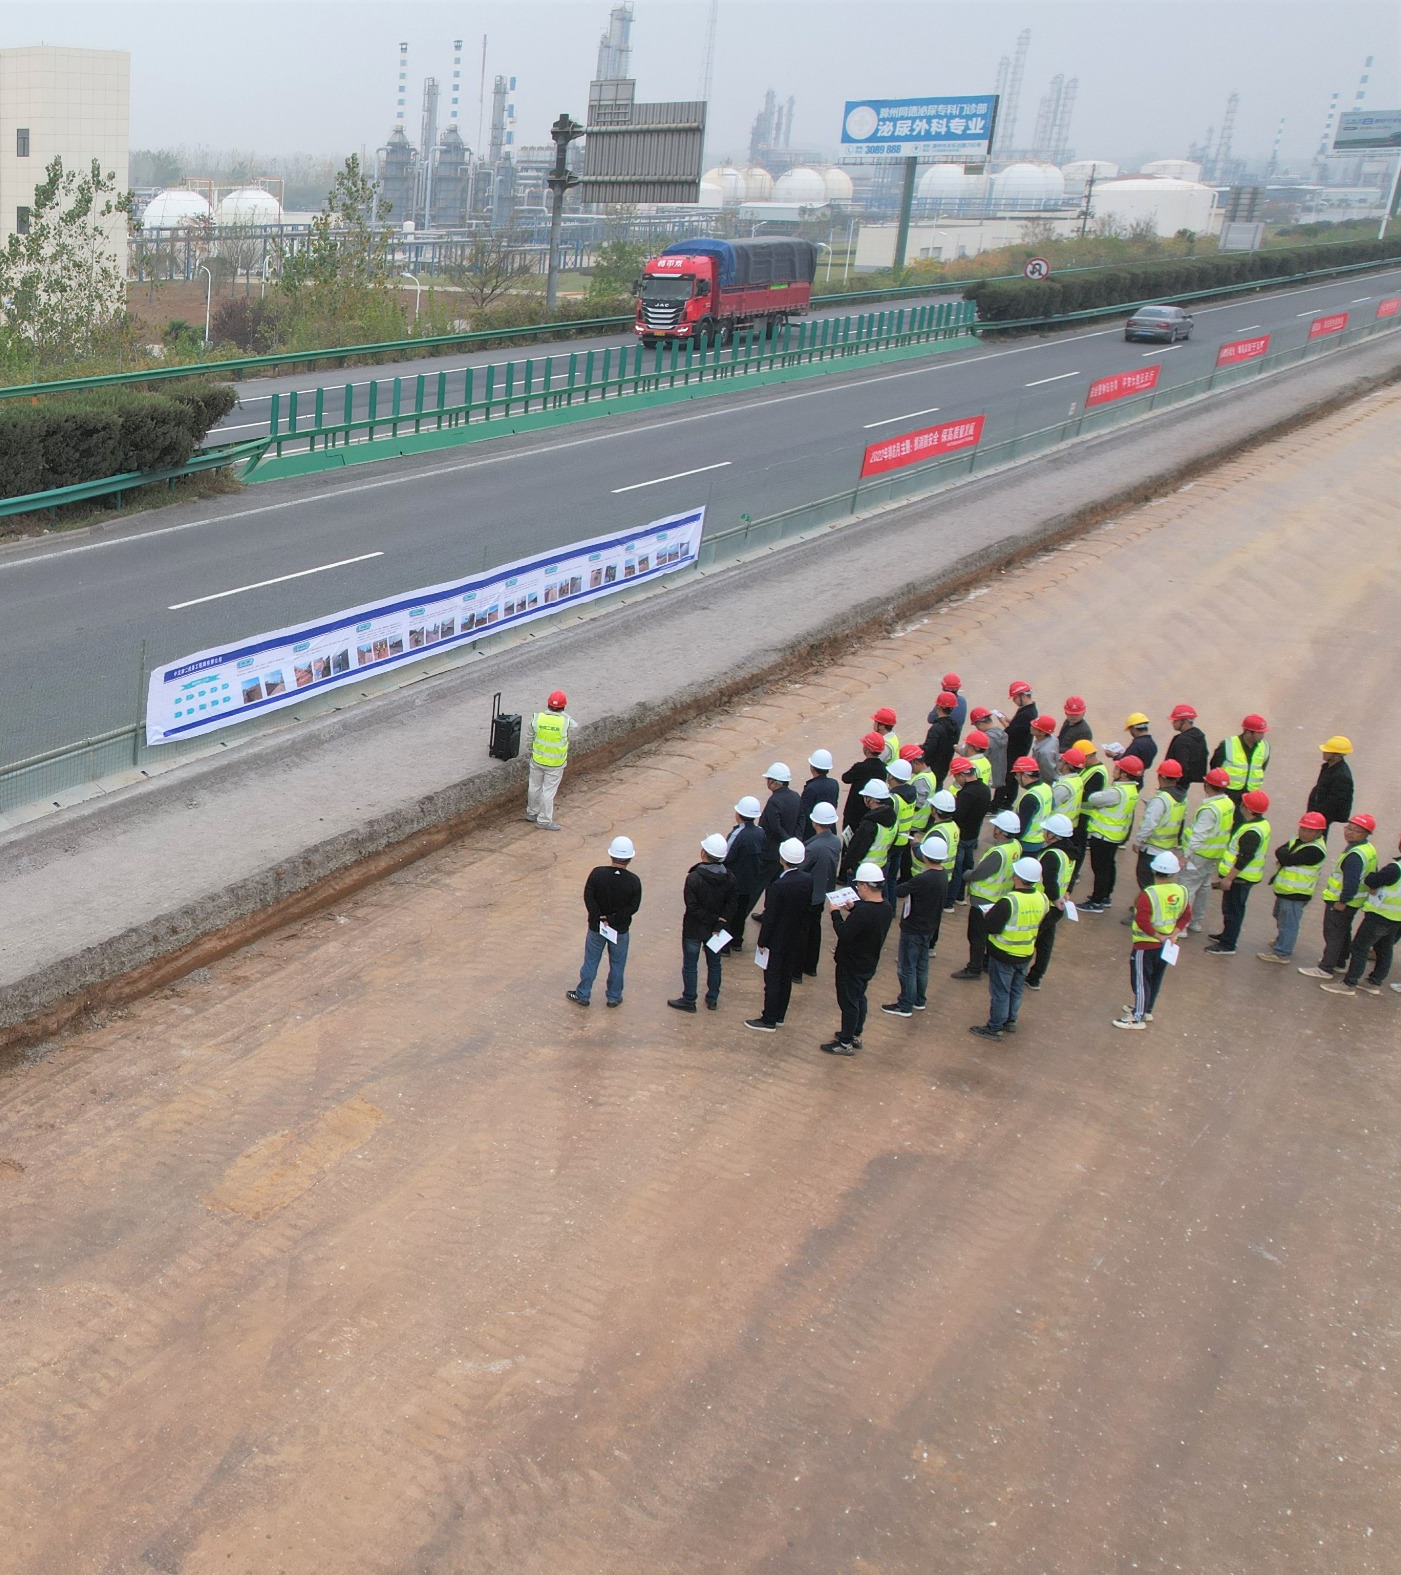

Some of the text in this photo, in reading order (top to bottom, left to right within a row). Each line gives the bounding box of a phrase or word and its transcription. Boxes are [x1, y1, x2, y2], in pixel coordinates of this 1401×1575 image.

[877, 117, 986, 137] 泌尿外科专业
[865, 145, 885, 154] 3089
